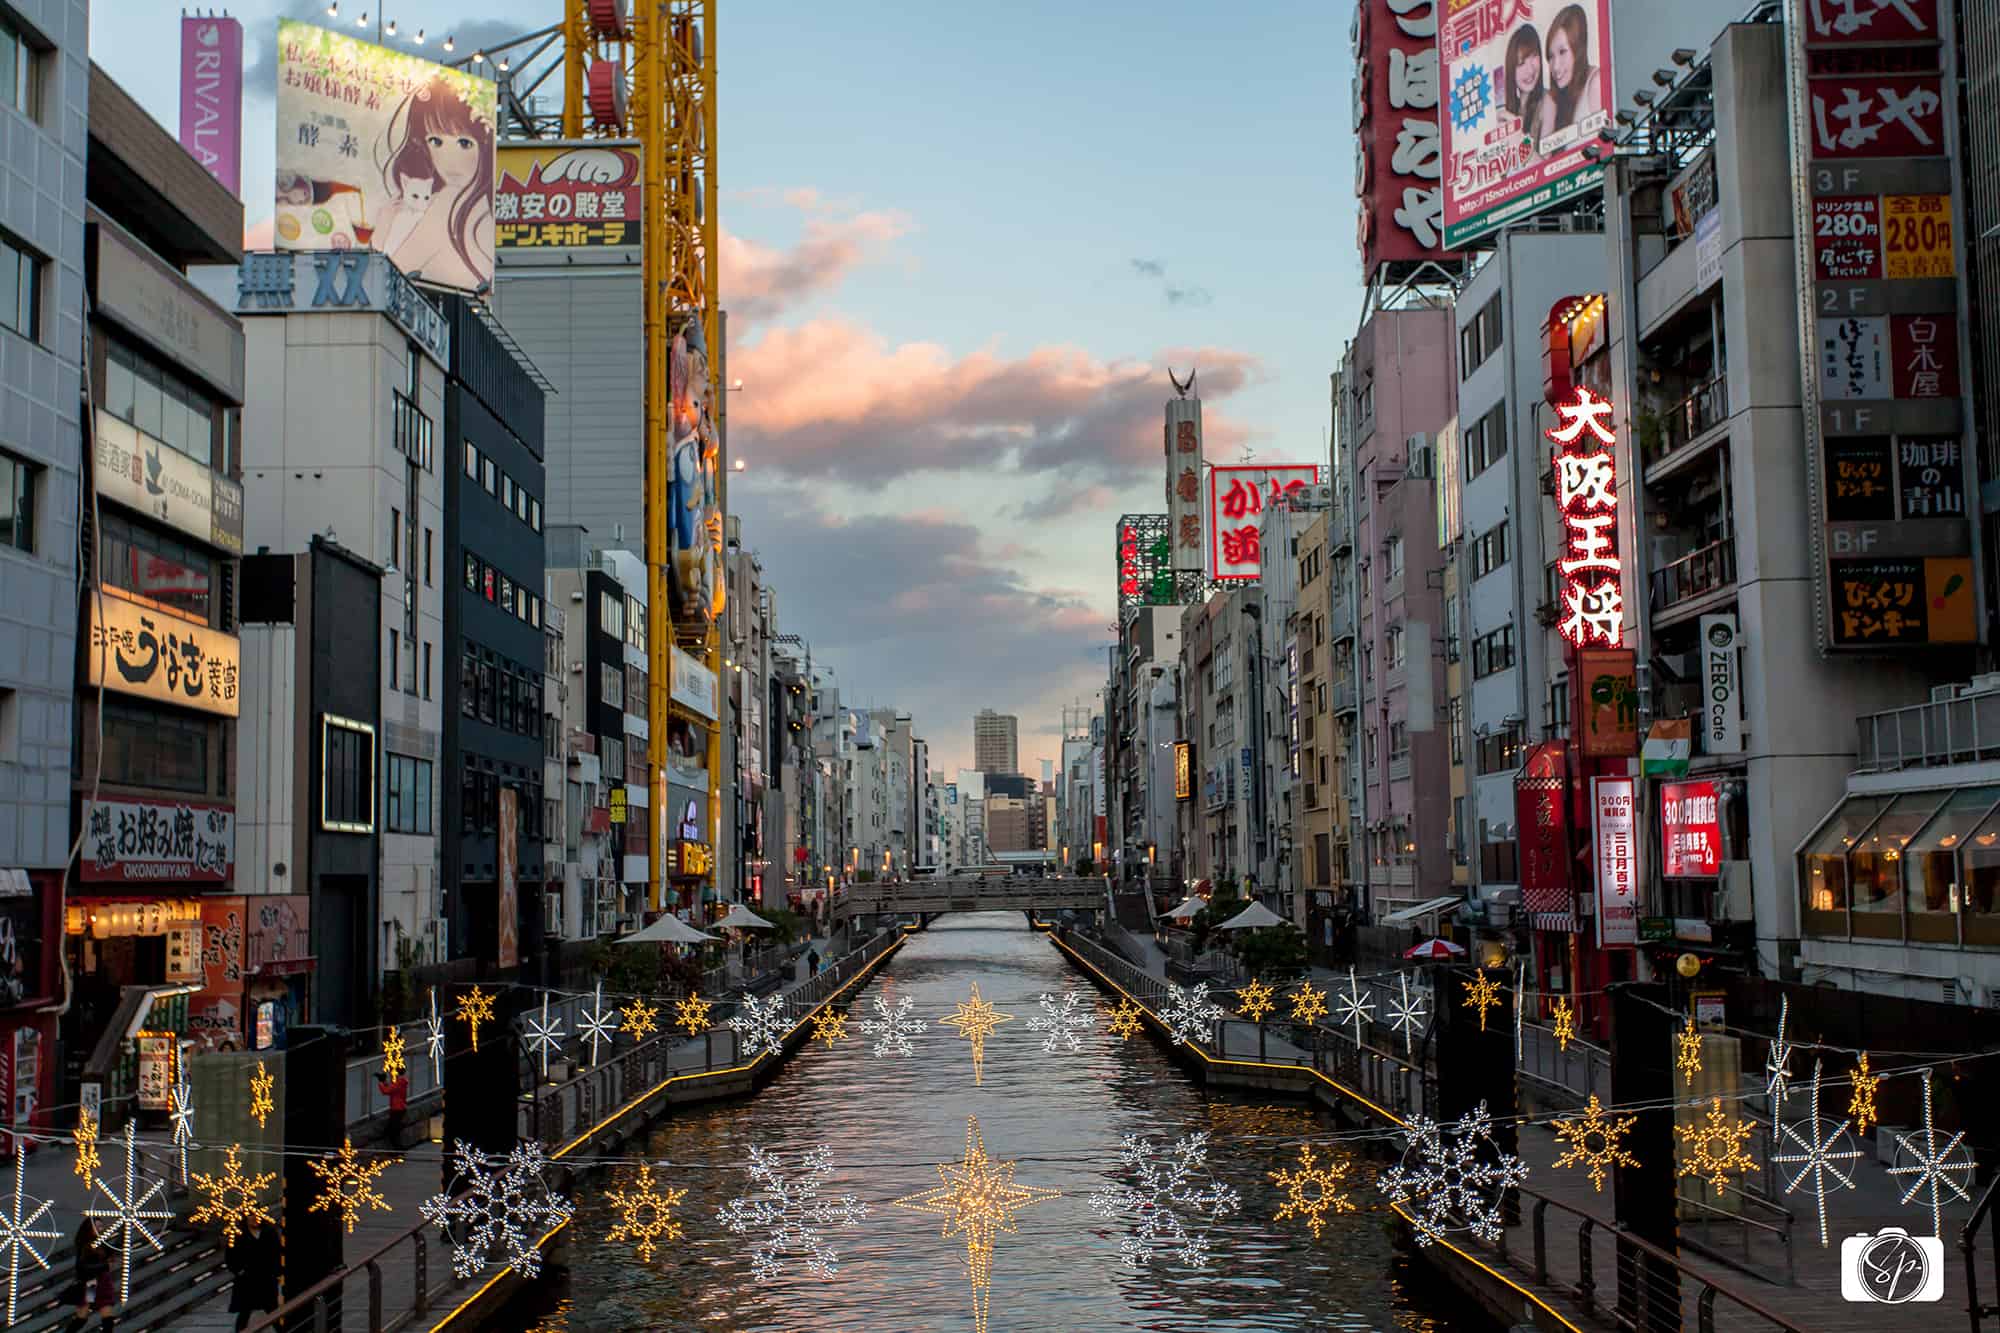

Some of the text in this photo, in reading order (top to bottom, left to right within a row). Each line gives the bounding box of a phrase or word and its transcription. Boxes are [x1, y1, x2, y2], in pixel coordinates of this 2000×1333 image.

[194, 51, 221, 178] RIVALA
[496, 192, 625, 219] 激安の殿堂
[1815, 213, 1879, 237] 280円
[1907, 315, 1943, 398] 白木屋
[1901, 440, 1960, 468] 珈琲
[1921, 467, 1941, 486] の
[1903, 486, 1961, 515] 青山
[1549, 386, 1624, 648] 大阪王将
[1843, 579, 1915, 609] びっくり
[1841, 610, 1921, 639] ドンキー
[116, 616, 206, 698] うなぎ
[1710, 652, 1730, 702] ZERO
[117, 804, 195, 859] お好み焼
[123, 863, 191, 878] OKONOMIYAKI
